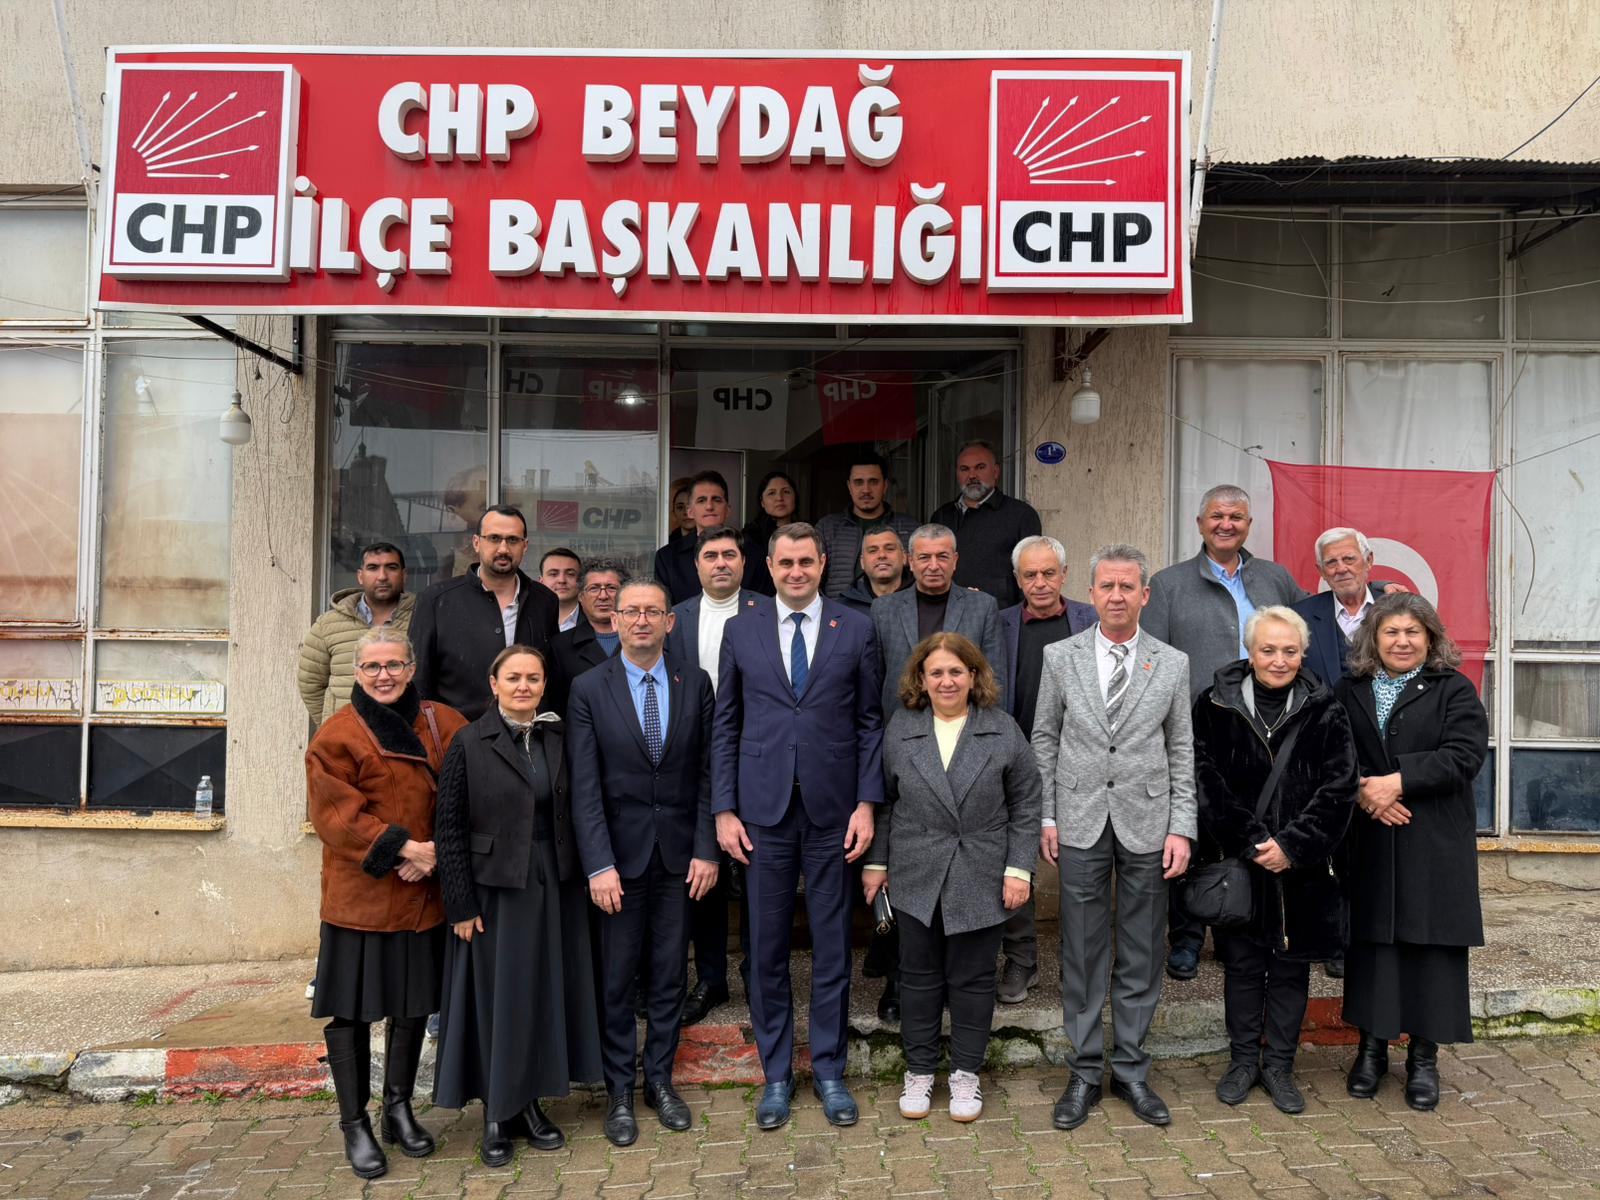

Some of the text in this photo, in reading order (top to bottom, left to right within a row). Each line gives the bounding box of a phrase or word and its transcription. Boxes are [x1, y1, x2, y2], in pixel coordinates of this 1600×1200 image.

[378, 64, 903, 167] CHP BEYDAĞ
[126, 202, 262, 255] CHP
[289, 176, 982, 298] İLÇE BAŞKANLIĞI
[1012, 211, 1153, 263] CHP
[583, 507, 642, 529] CHP
